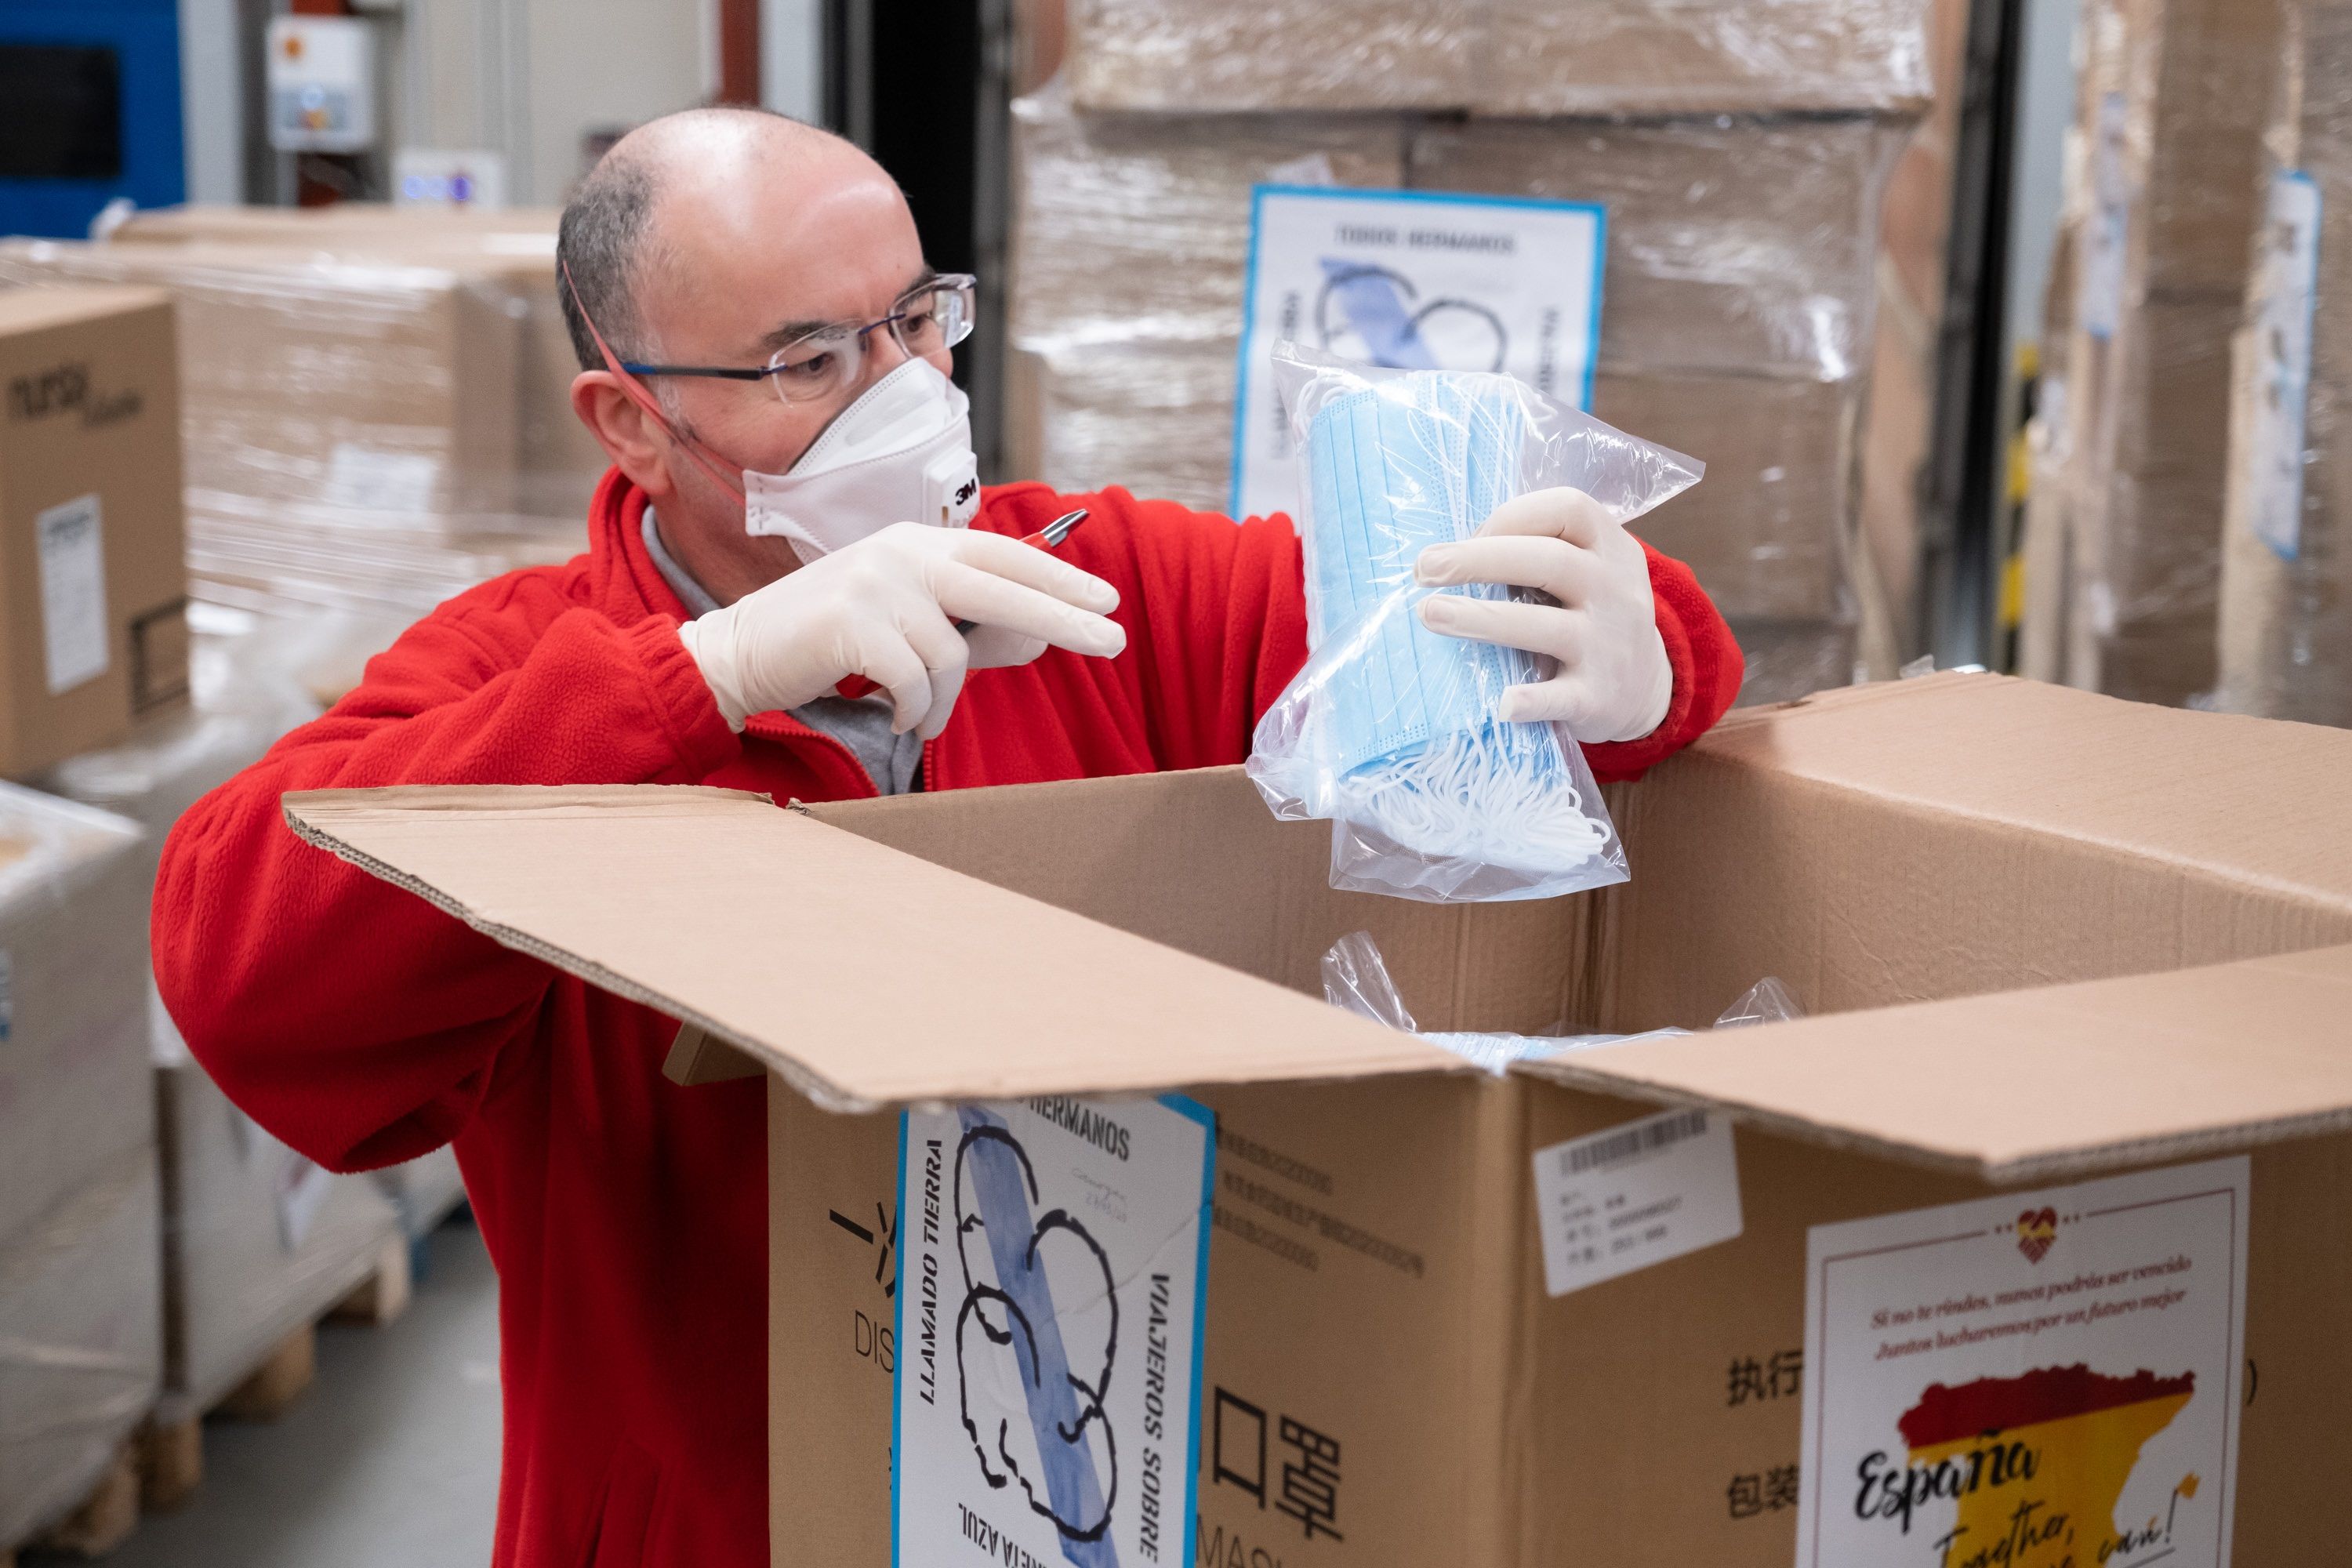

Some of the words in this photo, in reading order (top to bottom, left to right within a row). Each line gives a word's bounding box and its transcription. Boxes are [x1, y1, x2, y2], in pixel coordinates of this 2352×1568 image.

[955, 478, 977, 506] 3M
[924, 1139, 942, 1246] TIERRA
[920, 1254, 938, 1406] LLAMADO
[1145, 1273, 1171, 1441] VIAJEROS
[1727, 1349, 1805, 1407] 执行
[1139, 1447, 1163, 1564] SOBRE
[1213, 1385, 1344, 1541] 口罩
[1727, 1463, 1801, 1519] 包装
[1854, 1428, 2038, 1534] España
[958, 1502, 999, 1558] AZUL
[1196, 1513, 1282, 1568] MA
